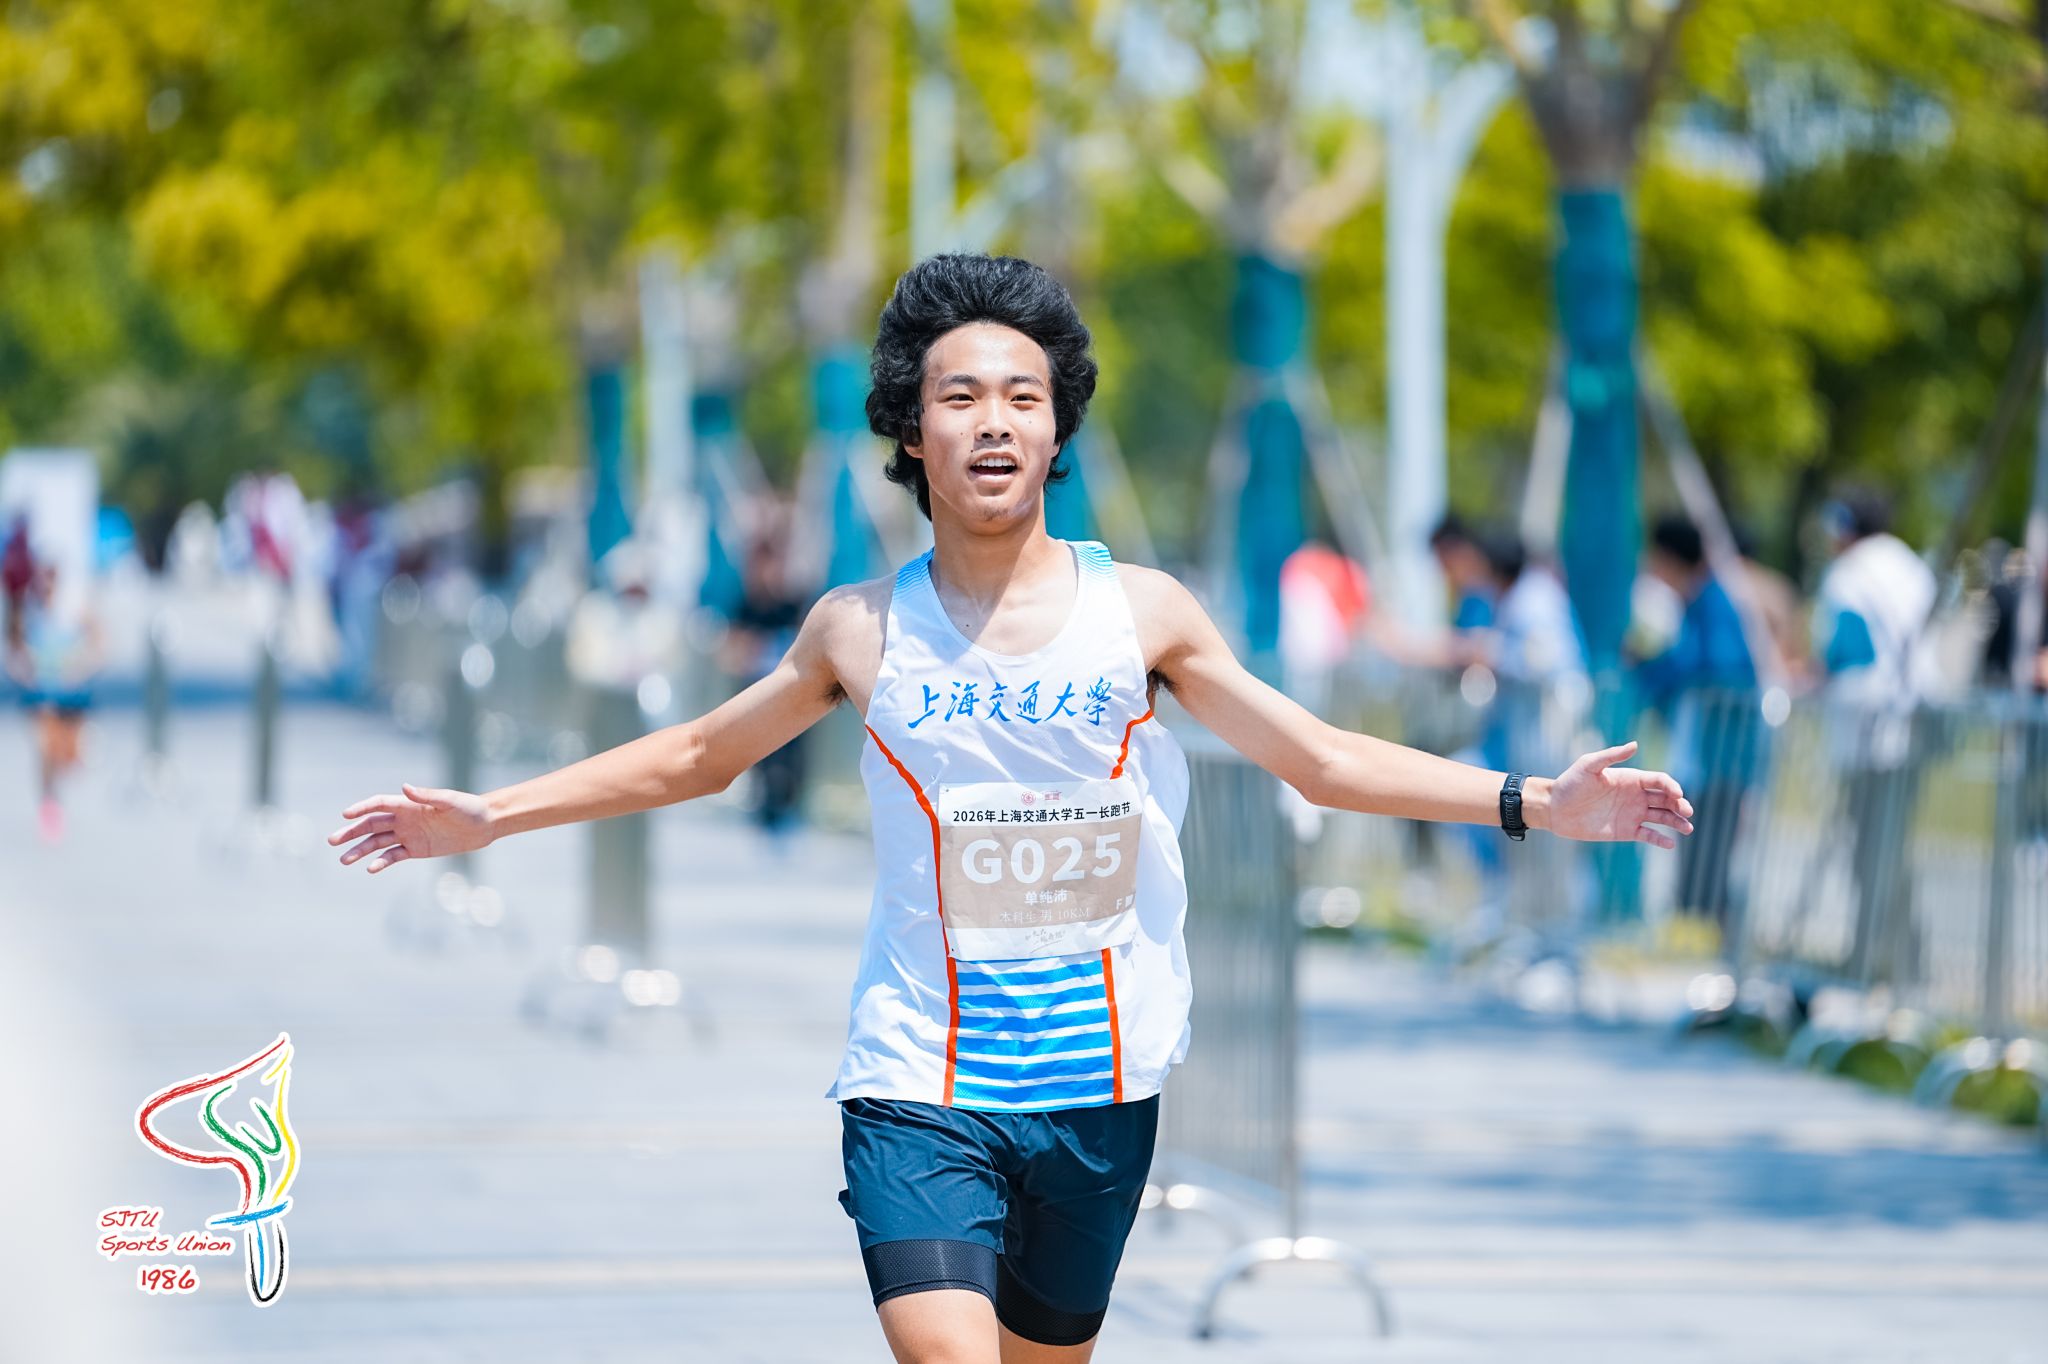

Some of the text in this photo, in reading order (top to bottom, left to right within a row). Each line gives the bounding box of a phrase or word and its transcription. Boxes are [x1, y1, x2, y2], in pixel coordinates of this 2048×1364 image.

[953, 801, 1131, 823] 2026年上海交通大学五一长跑节
[961, 832, 1122, 884] G025
[1058, 907, 1090, 921] 10KM
